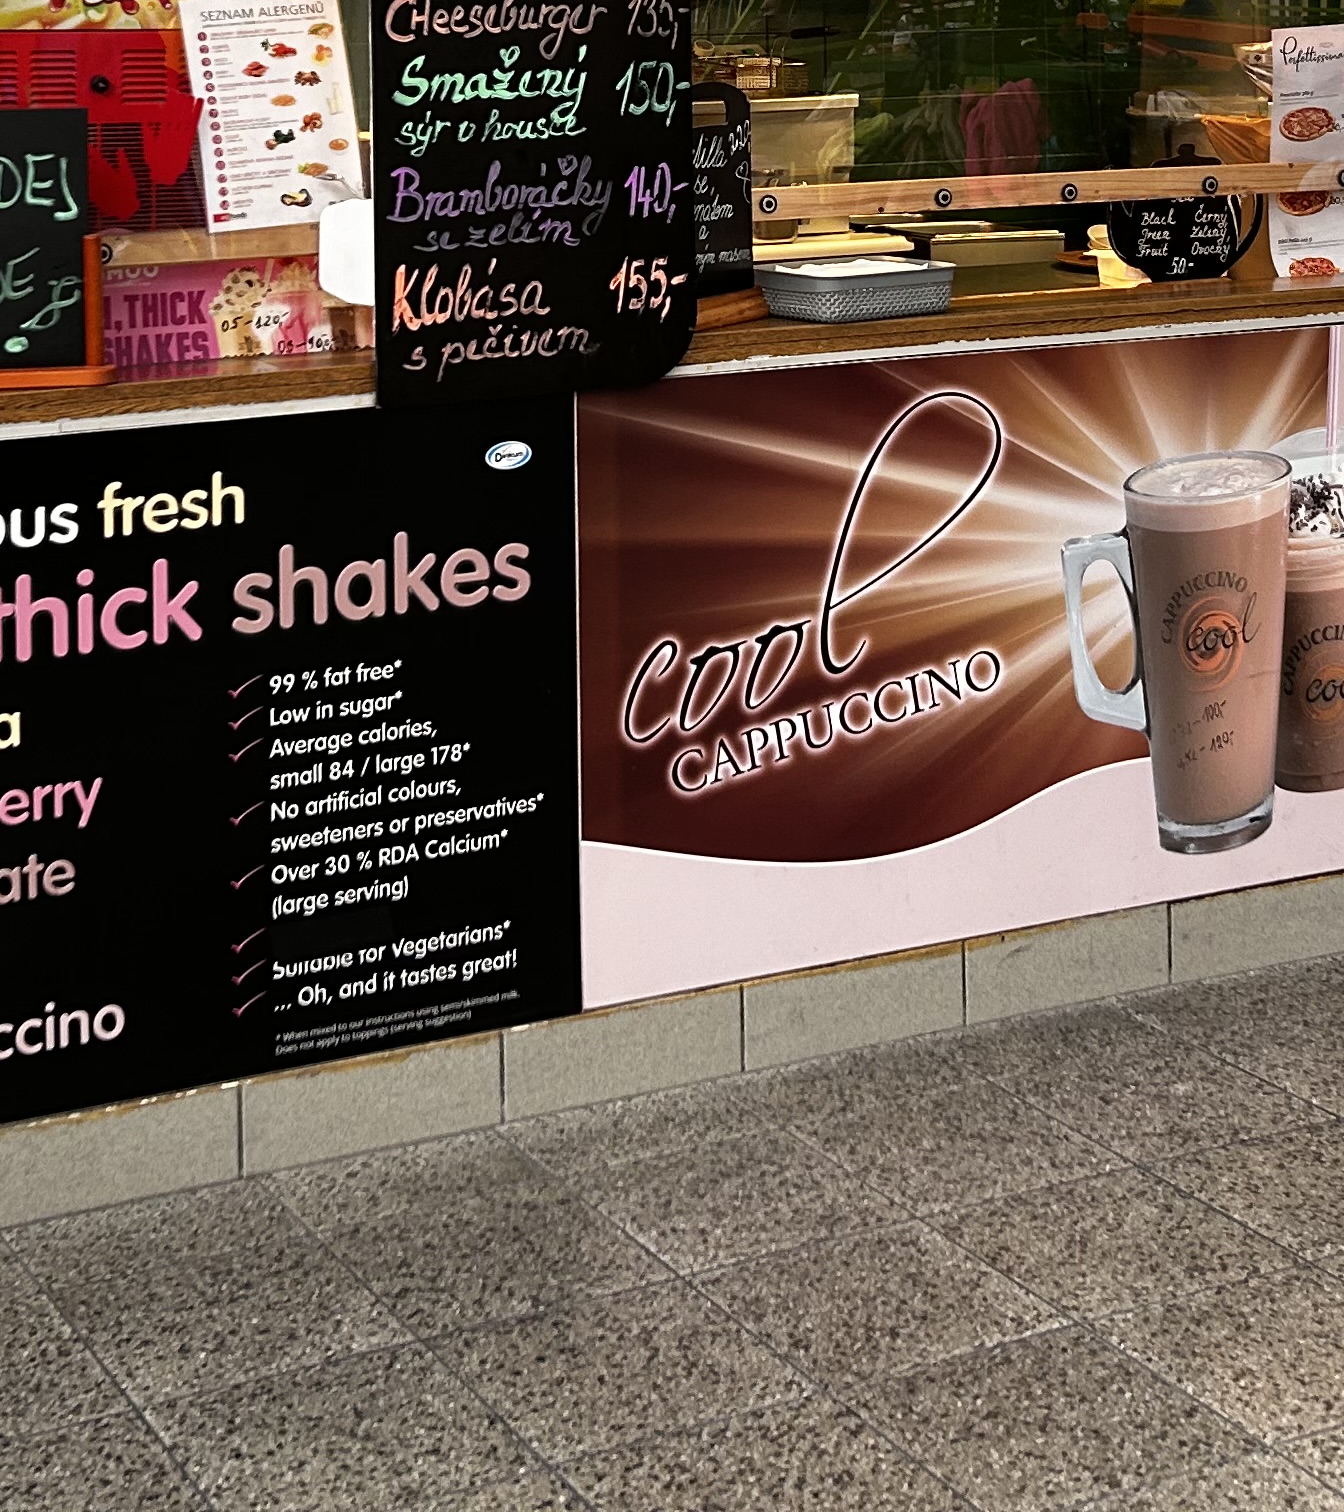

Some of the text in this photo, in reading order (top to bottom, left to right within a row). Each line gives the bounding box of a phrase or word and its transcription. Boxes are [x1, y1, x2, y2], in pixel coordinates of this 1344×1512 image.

[201, 2, 325, 21] SEZNAM ALERGENŮ
[392, 45, 588, 122] Smažený
[387, 155, 613, 236] Bramboráčky
[1141, 208, 1176, 225] Black
[392, 259, 551, 333] Klobása
[97, 471, 247, 539] fresh
[231, 531, 532, 637] shakes
[622, 389, 1004, 747] cool
[1162, 571, 1248, 644] CAPPUCCINO
[270, 674, 295, 694] 99
[301, 671, 317, 690] %
[323, 667, 352, 687] fat
[270, 705, 310, 726] Low
[316, 702, 334, 720] in
[668, 649, 1002, 797] CAPPUCCINO
[269, 719, 438, 759] Average calories,
[270, 764, 323, 789] small
[328, 760, 355, 780] 84
[375, 753, 425, 777] large
[270, 778, 461, 822] No artificial colours,
[270, 821, 383, 854] sweeteners
[389, 816, 409, 834] or
[270, 863, 320, 884] Over
[325, 856, 350, 875] 30
[357, 852, 372, 871] %
[378, 843, 419, 868] RDA
[272, 877, 409, 920] (large serving)
[298, 949, 518, 1008] Oh, and it tastes great!
